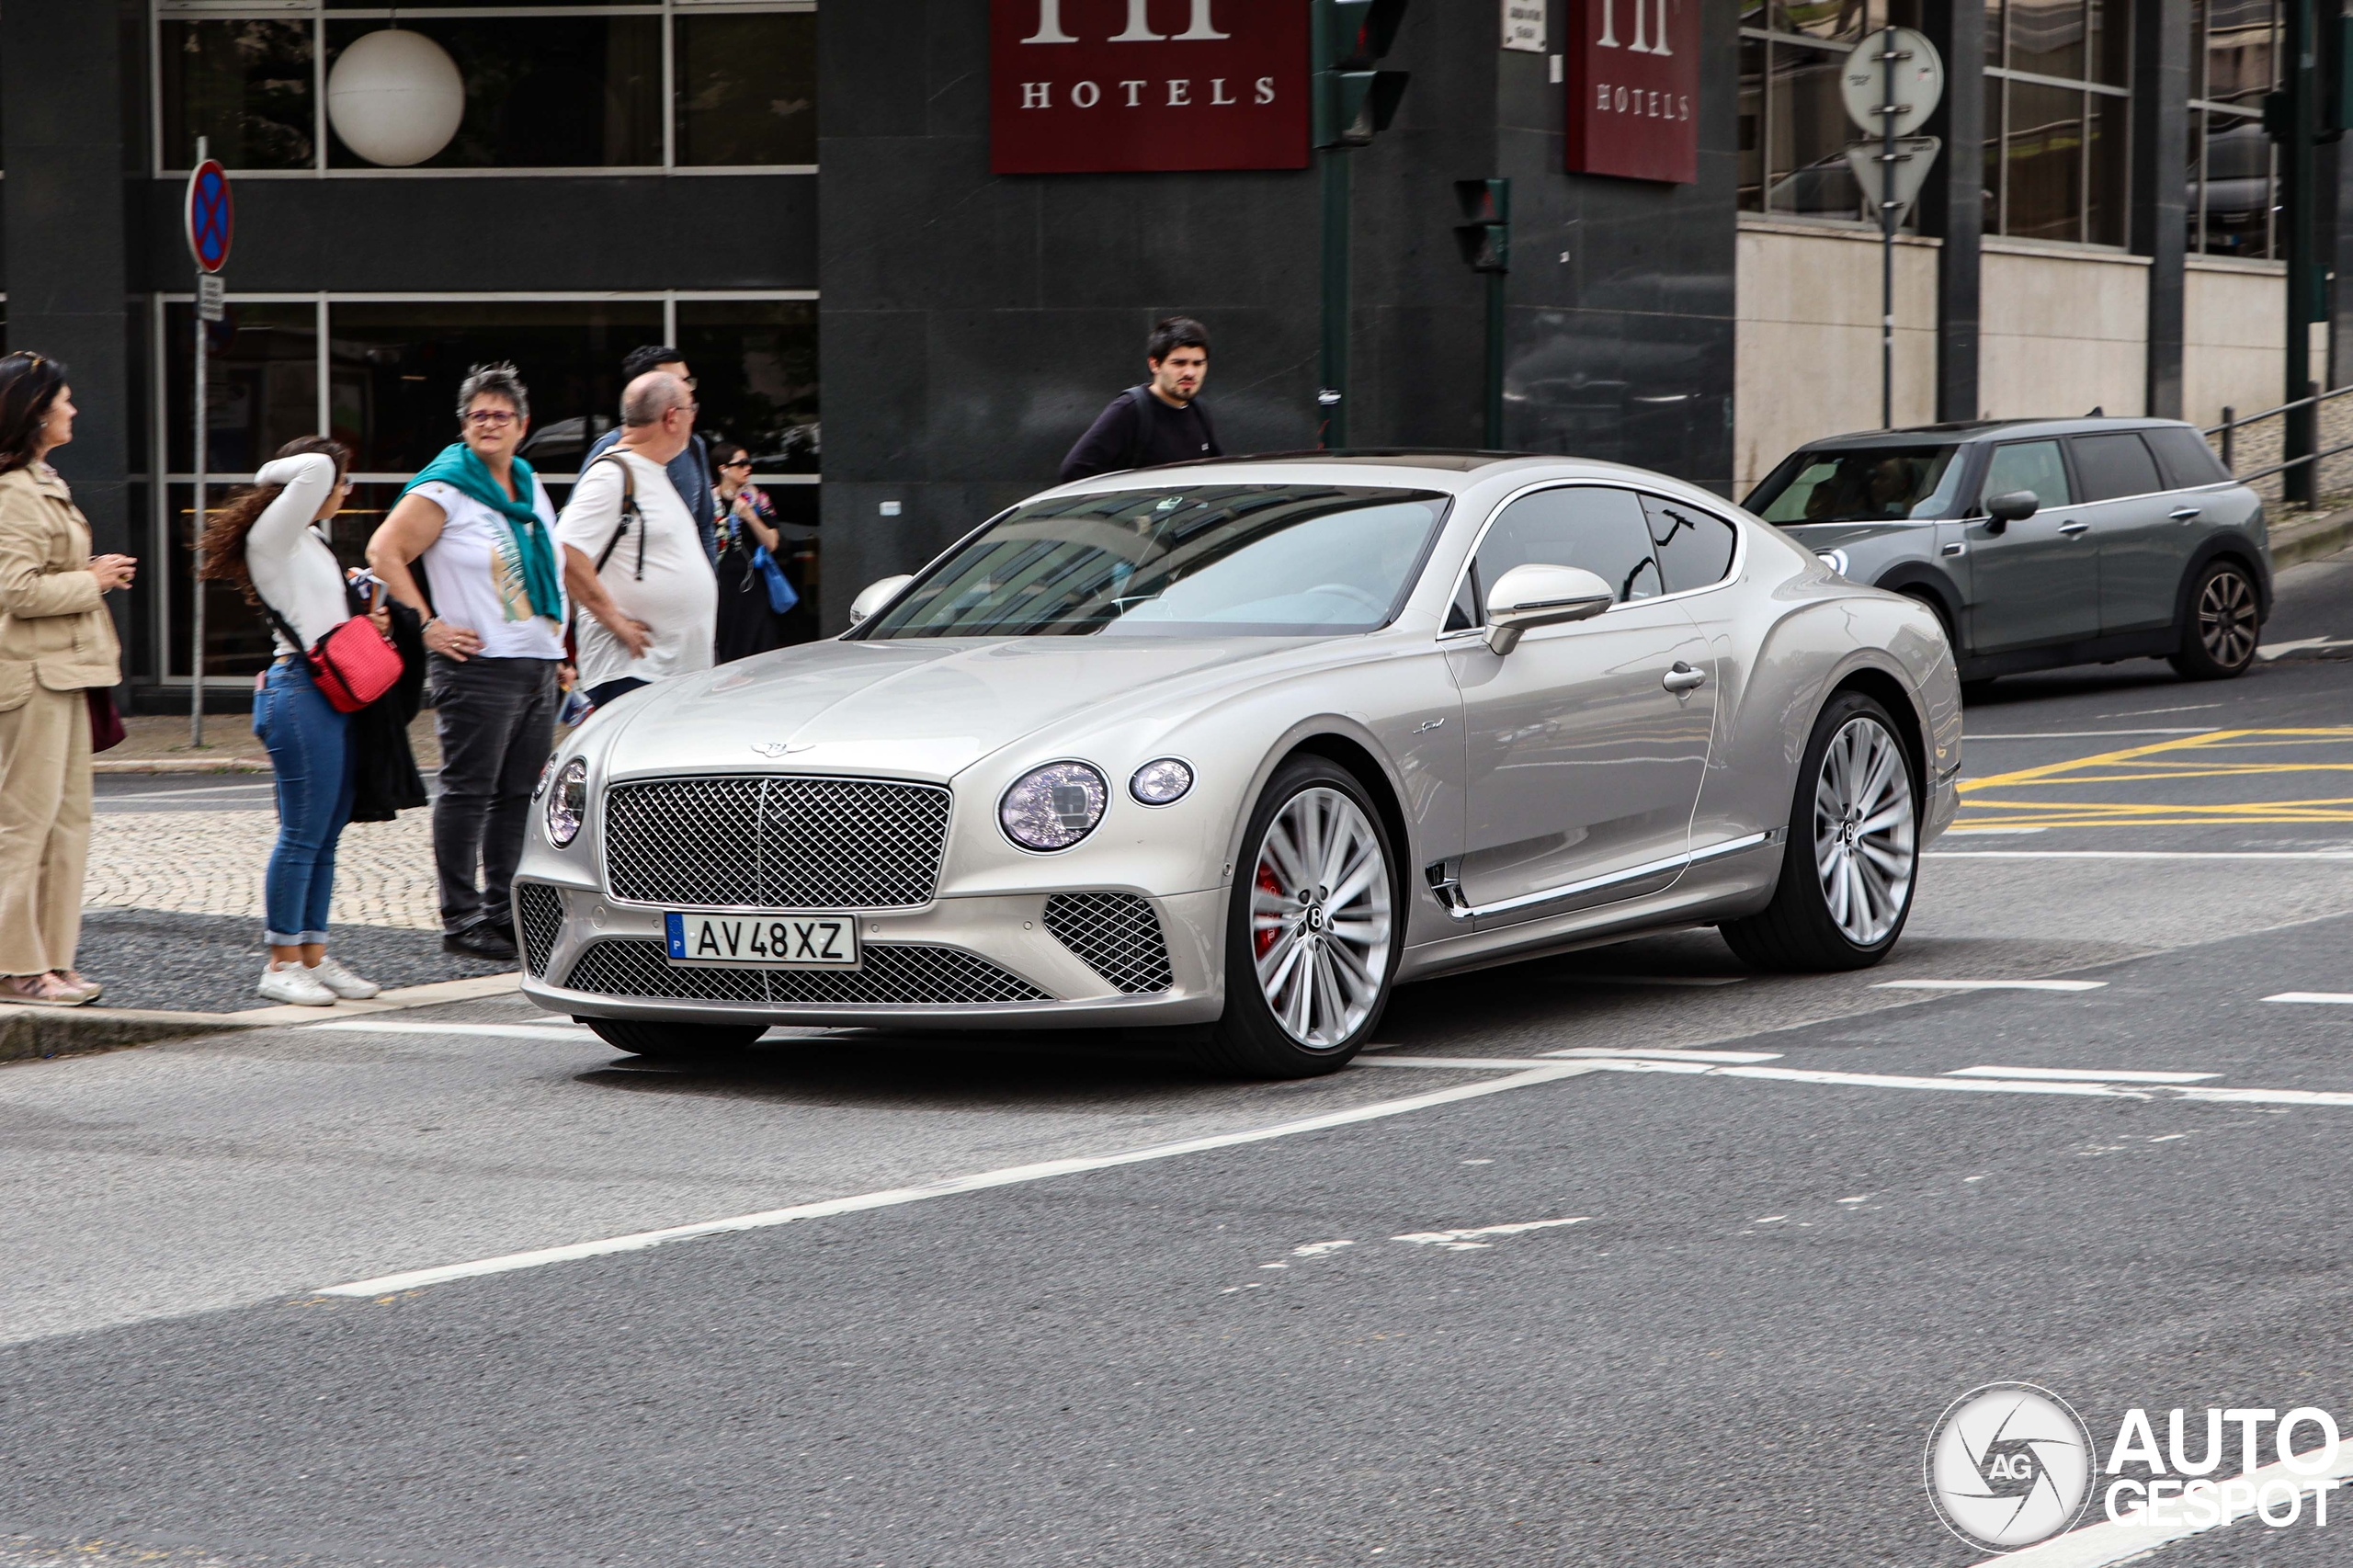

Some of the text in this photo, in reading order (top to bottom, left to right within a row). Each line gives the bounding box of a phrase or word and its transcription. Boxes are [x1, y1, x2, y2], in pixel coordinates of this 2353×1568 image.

[1019, 76, 1276, 109] HOTELS
[1596, 83, 1690, 121] HOTELS
[673, 939, 681, 950] P
